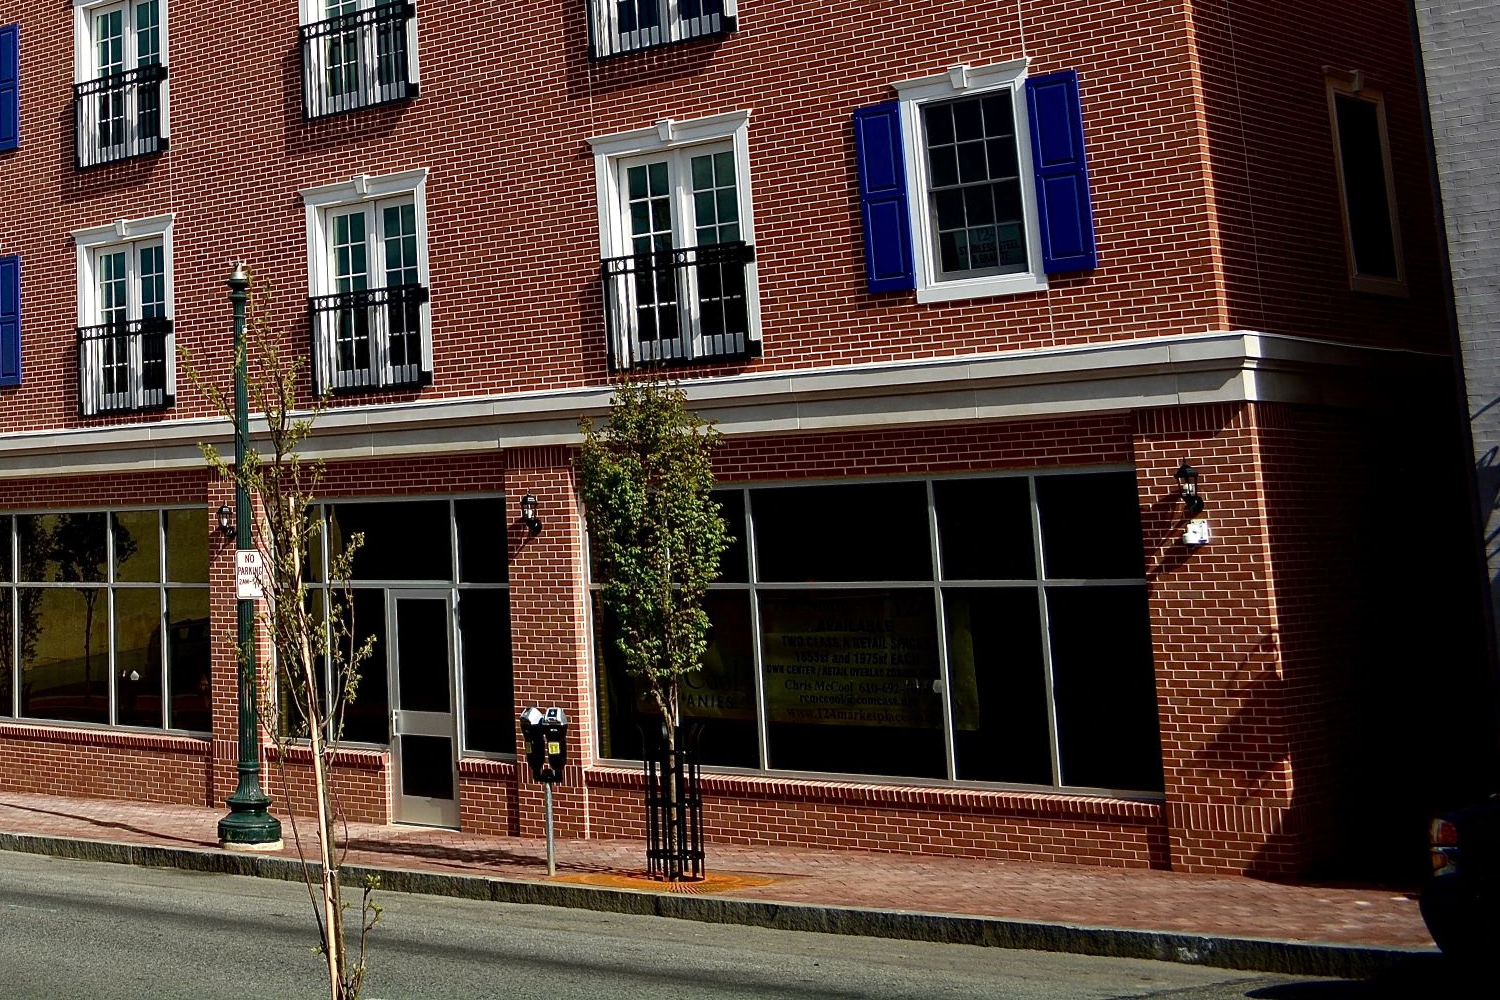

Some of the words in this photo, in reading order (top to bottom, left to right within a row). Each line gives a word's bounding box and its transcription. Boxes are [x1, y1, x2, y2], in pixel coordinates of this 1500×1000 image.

[244, 554, 255, 563] NO
[238, 566, 262, 575] PARKING
[818, 618, 893, 632] AVAILABLE
[781, 635, 804, 648] TWO
[806, 636, 838, 649] CLASS
[851, 637, 887, 650] RETAIL
[832, 652, 850, 664] and
[853, 652, 888, 665] 1975sf
[766, 664, 784, 673] OWN
[786, 665, 816, 675] CENTER
[821, 666, 849, 677] RETAIL
[850, 667, 883, 678] OVERLAY
[784, 679, 812, 691] Chris
[815, 680, 854, 693] McCool
